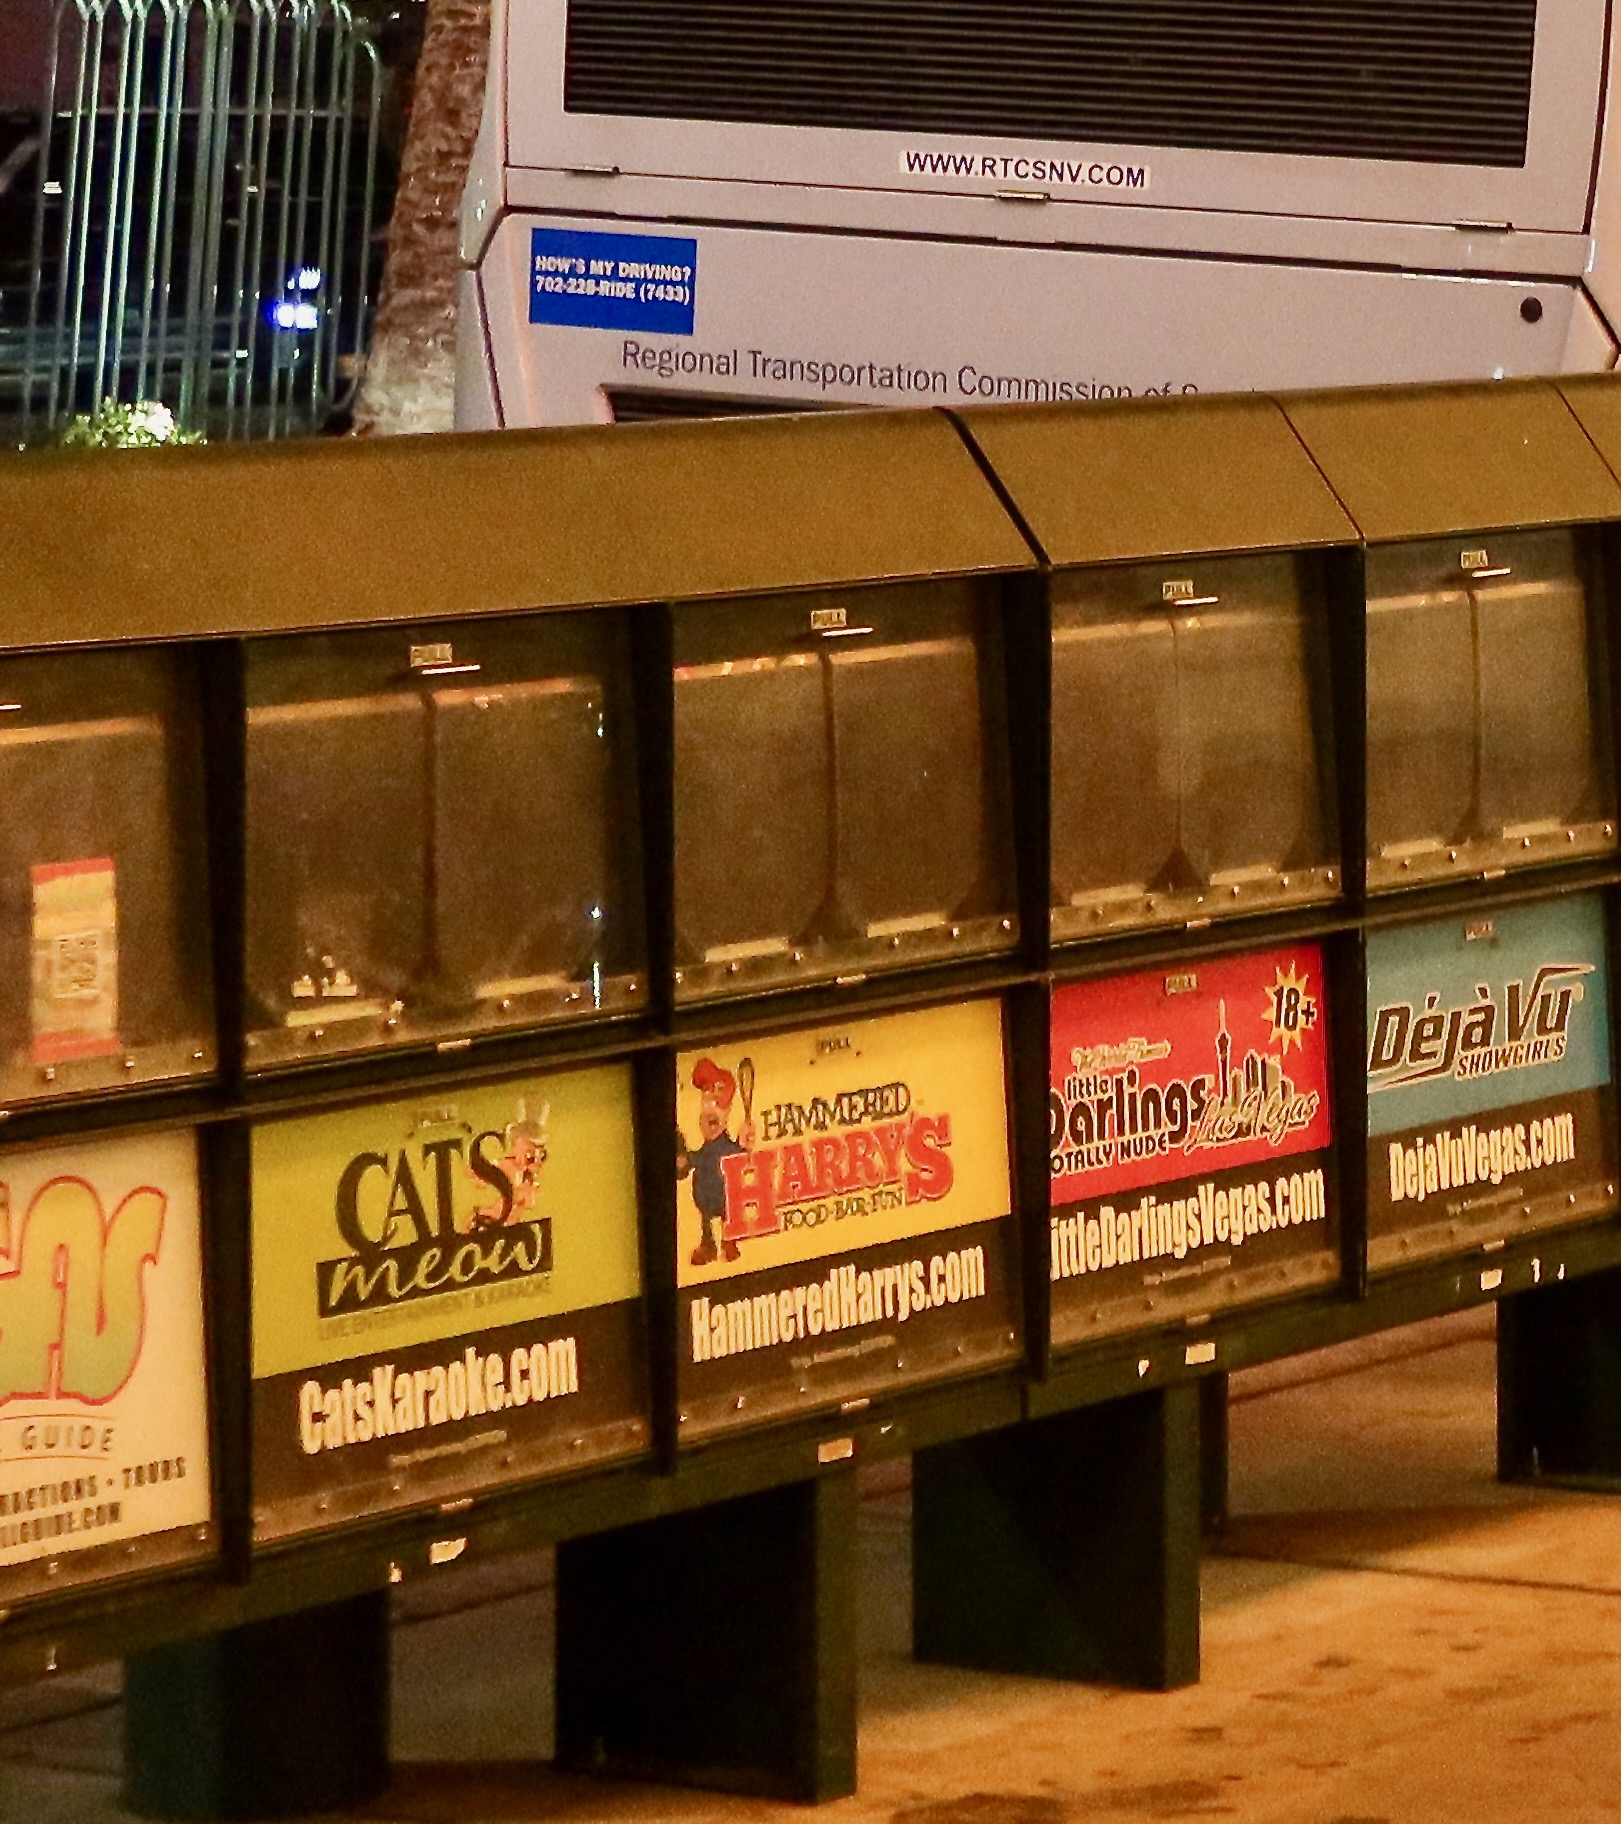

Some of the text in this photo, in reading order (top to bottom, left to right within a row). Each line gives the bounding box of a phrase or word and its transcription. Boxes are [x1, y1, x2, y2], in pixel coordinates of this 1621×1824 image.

[905, 150, 1146, 189] WWW.RTCSNV.COM
[535, 255, 692, 282] HOW'S MY DRIVING?
[535, 274, 690, 306] 702-228-RIDE (7433)
[622, 339, 738, 378] Regional
[747, 349, 948, 394] Transportation
[957, 364, 1133, 402] Commission
[1272, 985, 1317, 1032] 18+
[1506, 966, 1592, 1043] Vu
[1066, 1073, 1112, 1102] little
[1456, 1037, 1567, 1079] SHOWGIRLS
[760, 1081, 911, 1142] HAMMERED
[720, 1111, 954, 1241] HARRY'S
[1051, 1132, 1169, 1175] OTALLY NUDE
[1388, 1112, 1575, 1203] DejaVuVegas.com
[335, 1130, 514, 1253] CATS
[1051, 1168, 1326, 1282] ittleDarlingsVegas.com
[328, 1222, 542, 1308] meow
[690, 1245, 986, 1364] HammeredHarrys.com
[299, 1336, 579, 1455] CatsKaraoke.com
[21, 1425, 113, 1452] GUIDE
